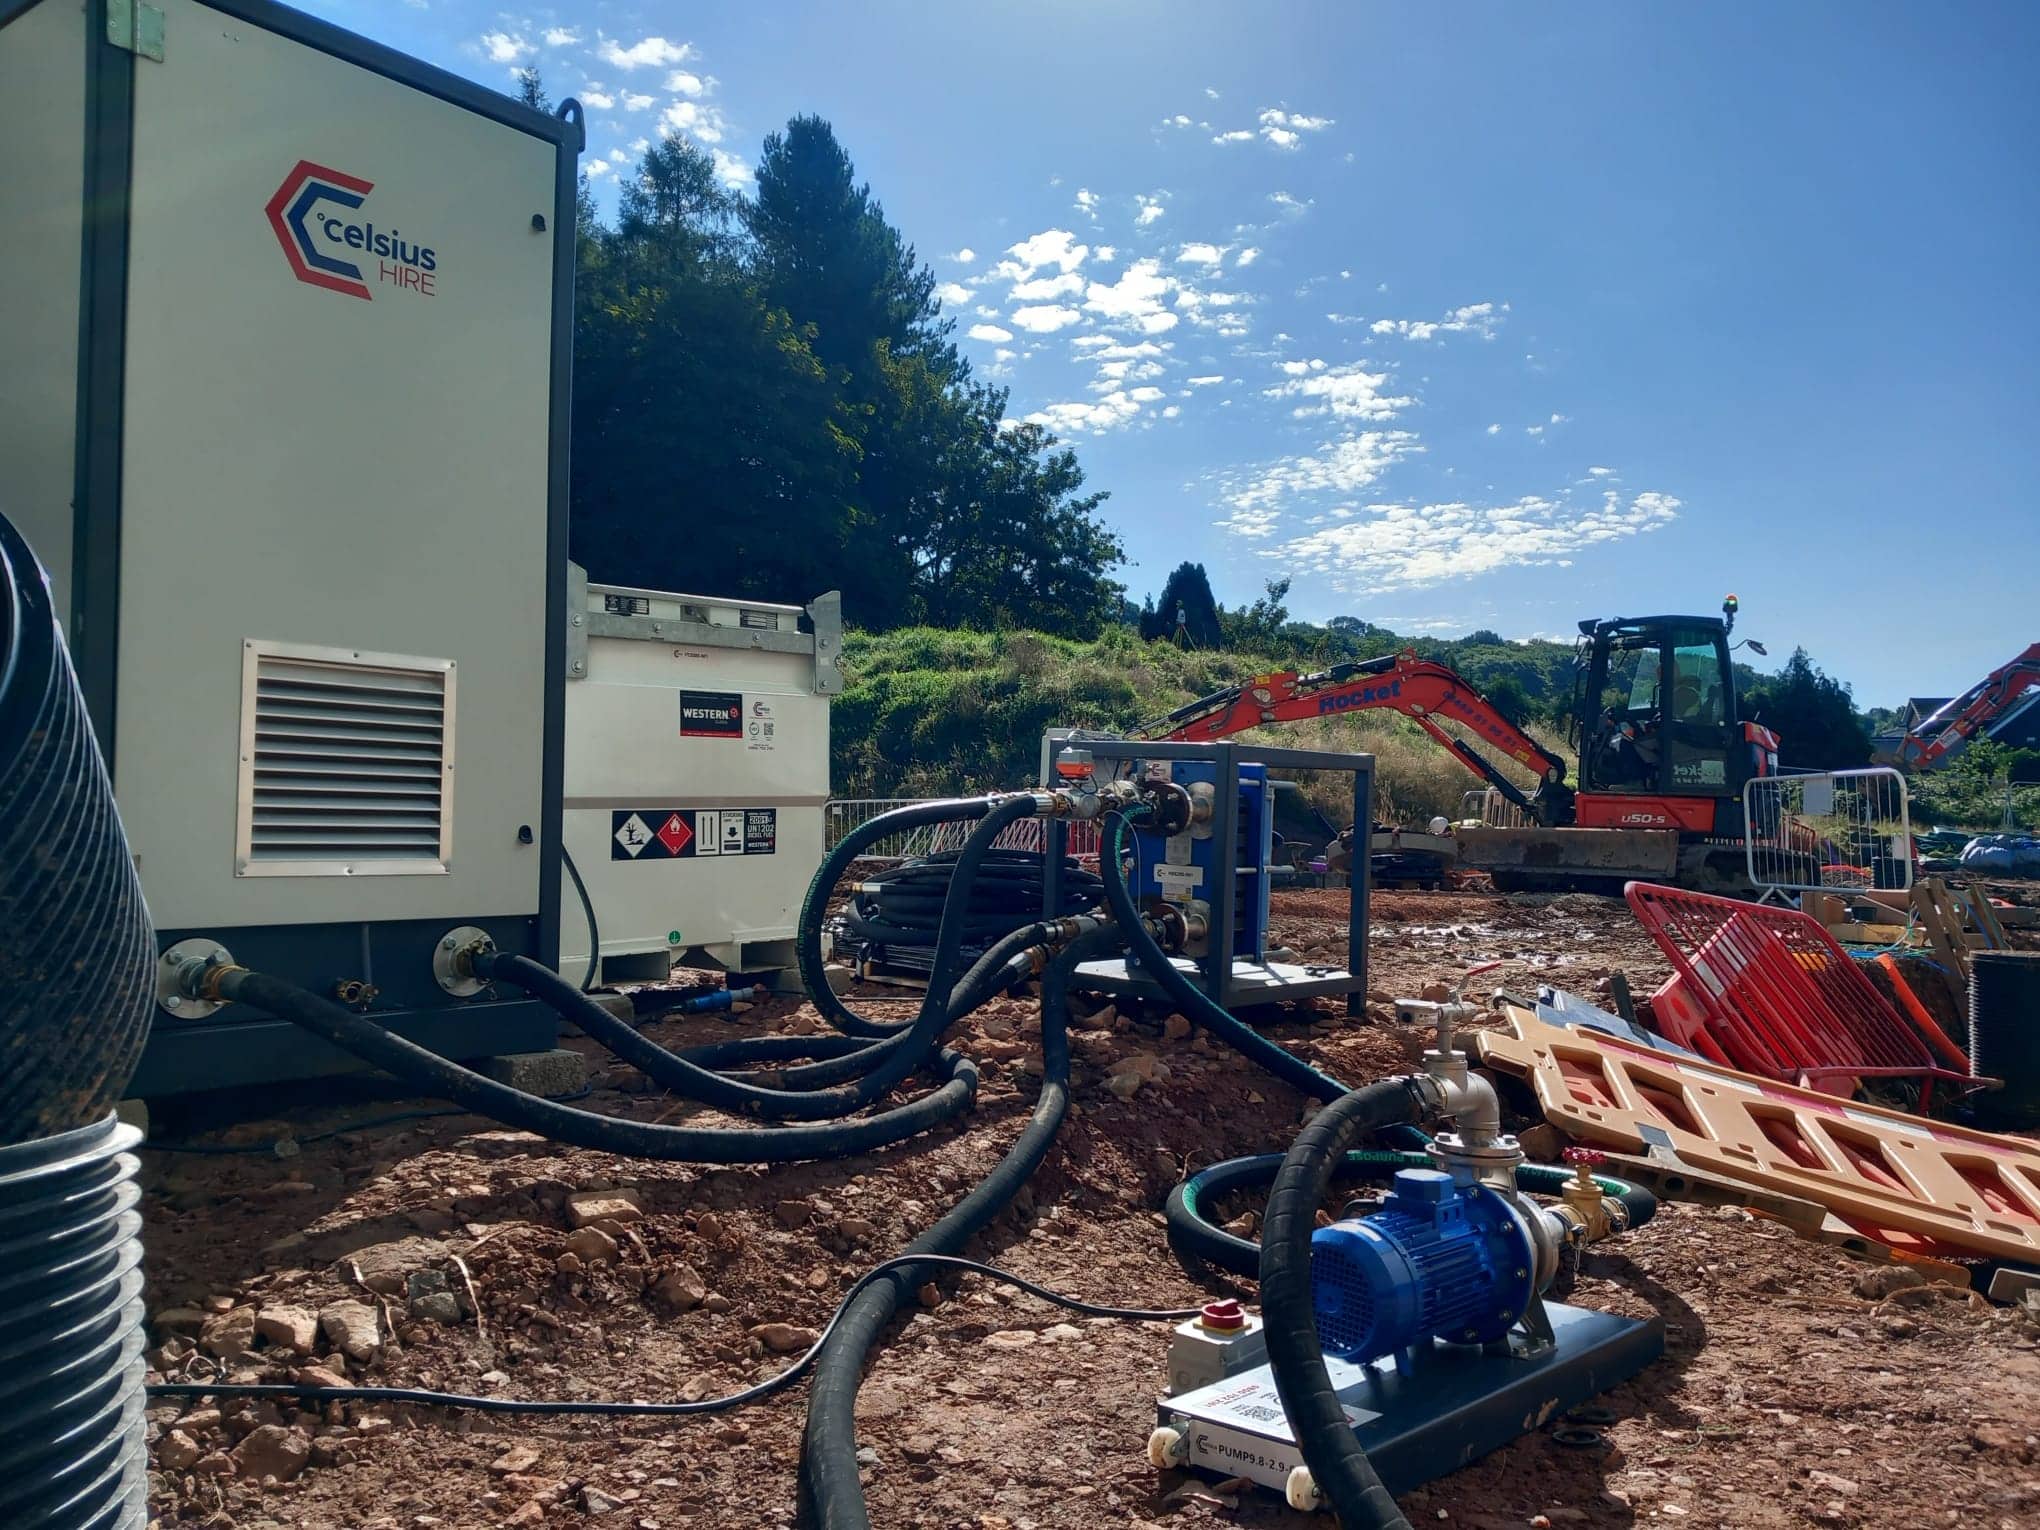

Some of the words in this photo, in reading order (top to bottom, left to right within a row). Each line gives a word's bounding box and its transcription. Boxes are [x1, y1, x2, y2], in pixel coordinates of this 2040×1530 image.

[380, 260, 436, 297] HIRE
[683, 707, 729, 720] WESTERN
[1319, 680, 1400, 714] Rocket
